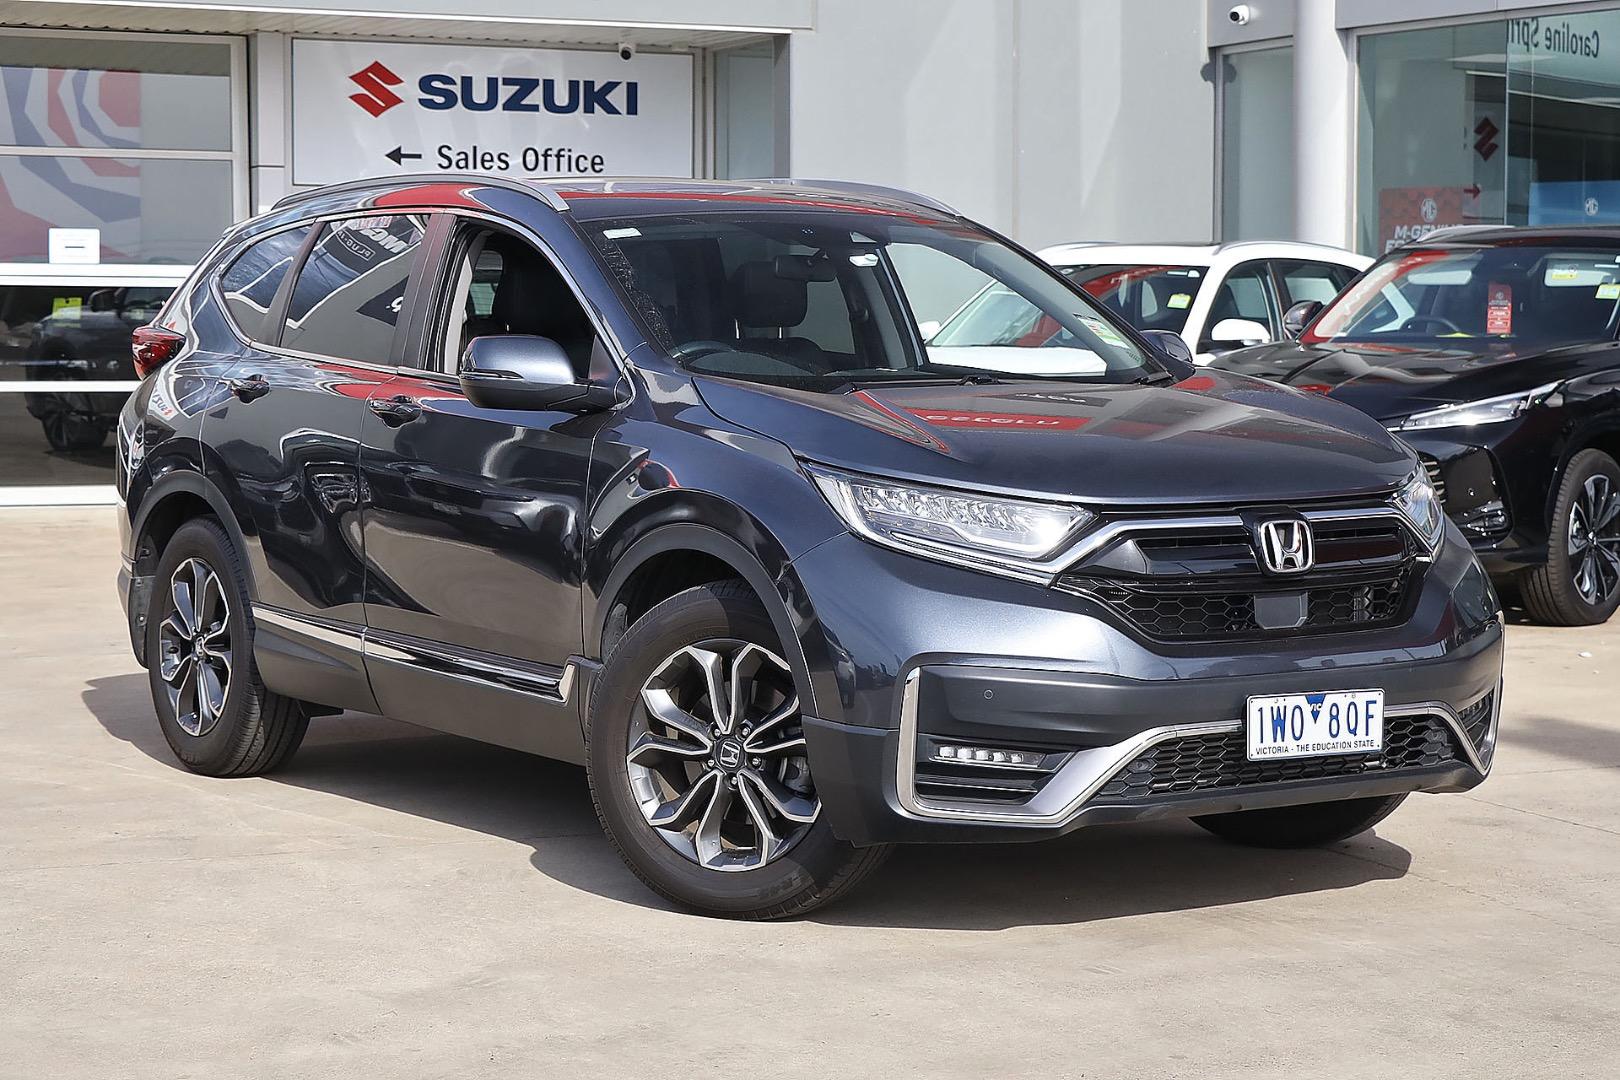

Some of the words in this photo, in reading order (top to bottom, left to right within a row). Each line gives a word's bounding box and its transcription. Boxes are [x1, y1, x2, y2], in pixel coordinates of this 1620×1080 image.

[417, 73, 639, 116] SUZUKI
[437, 144, 510, 171] Sales
[521, 146, 605, 173] Office
[1328, 700, 1377, 738] 8QF
[1255, 745, 1289, 755] VICTORIA
[1296, 744, 1310, 752] THE
[1311, 741, 1352, 751] EDUCATION
[1353, 739, 1375, 749] STATE
